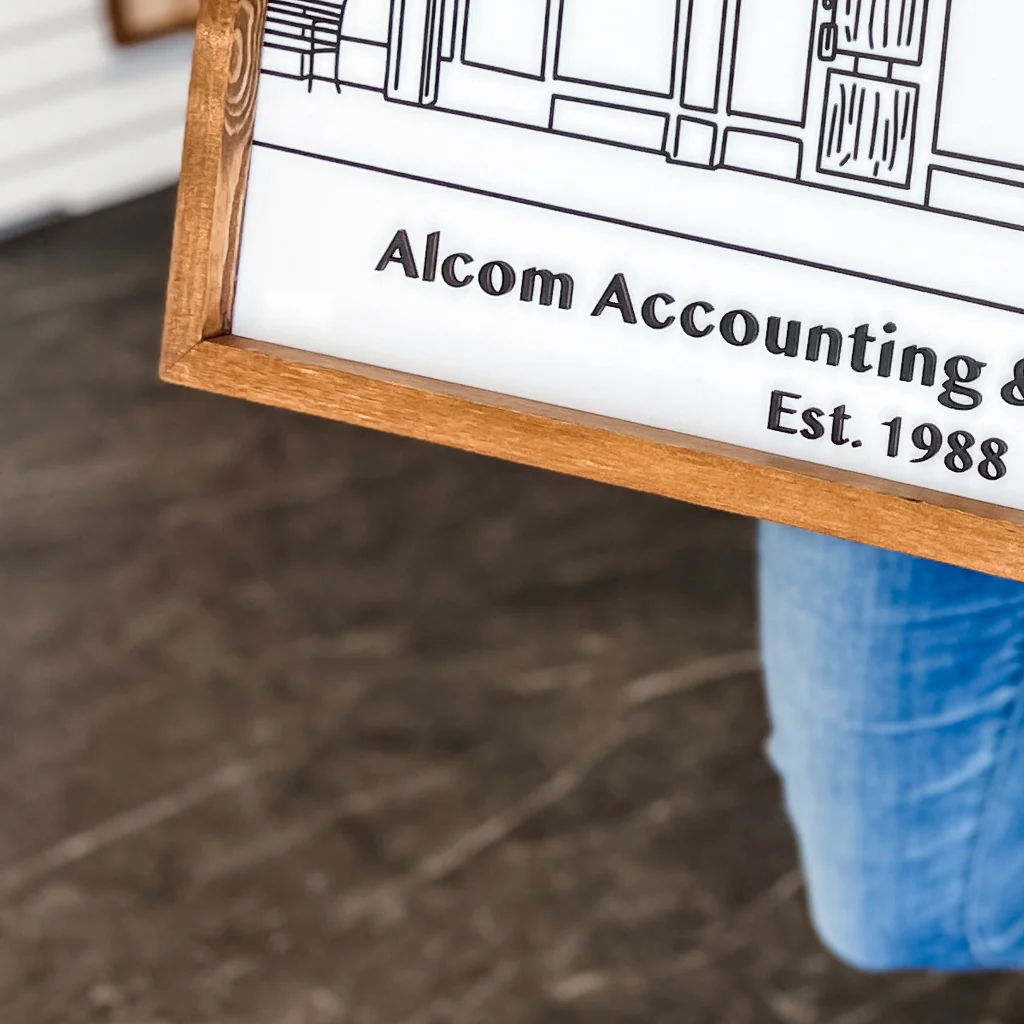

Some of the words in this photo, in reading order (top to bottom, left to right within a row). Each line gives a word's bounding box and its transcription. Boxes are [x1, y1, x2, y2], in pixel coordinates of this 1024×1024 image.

[375, 229, 575, 311] Alcom
[590, 272, 988, 411] Accounting
[766, 389, 863, 449] Est.
[881, 416, 1009, 481] 1988
